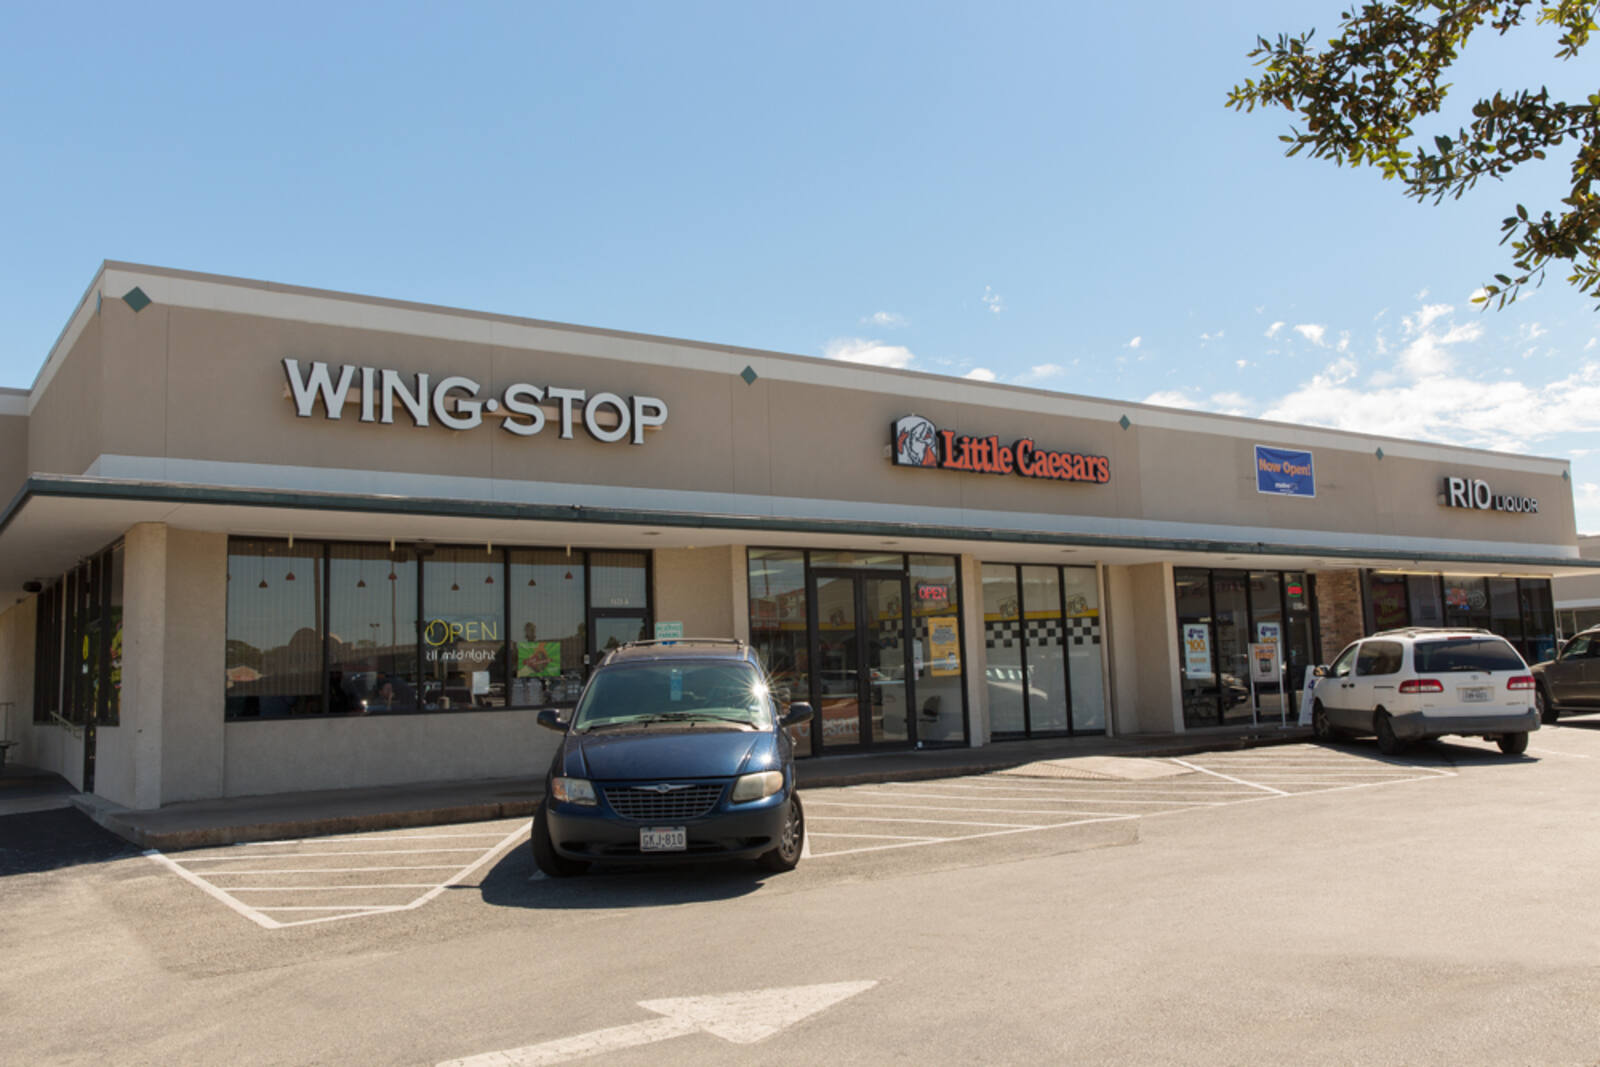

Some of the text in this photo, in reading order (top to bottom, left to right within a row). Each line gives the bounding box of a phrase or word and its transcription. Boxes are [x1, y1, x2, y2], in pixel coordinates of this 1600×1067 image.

[942, 429, 1110, 483] Little Caesars
[1258, 458, 1312, 477] Now Open!
[1448, 476, 1539, 513] RIO LIQUOR
[919, 586, 947, 600] OPEN
[424, 618, 497, 646] OPEN
[441, 648, 496, 663] midnight
